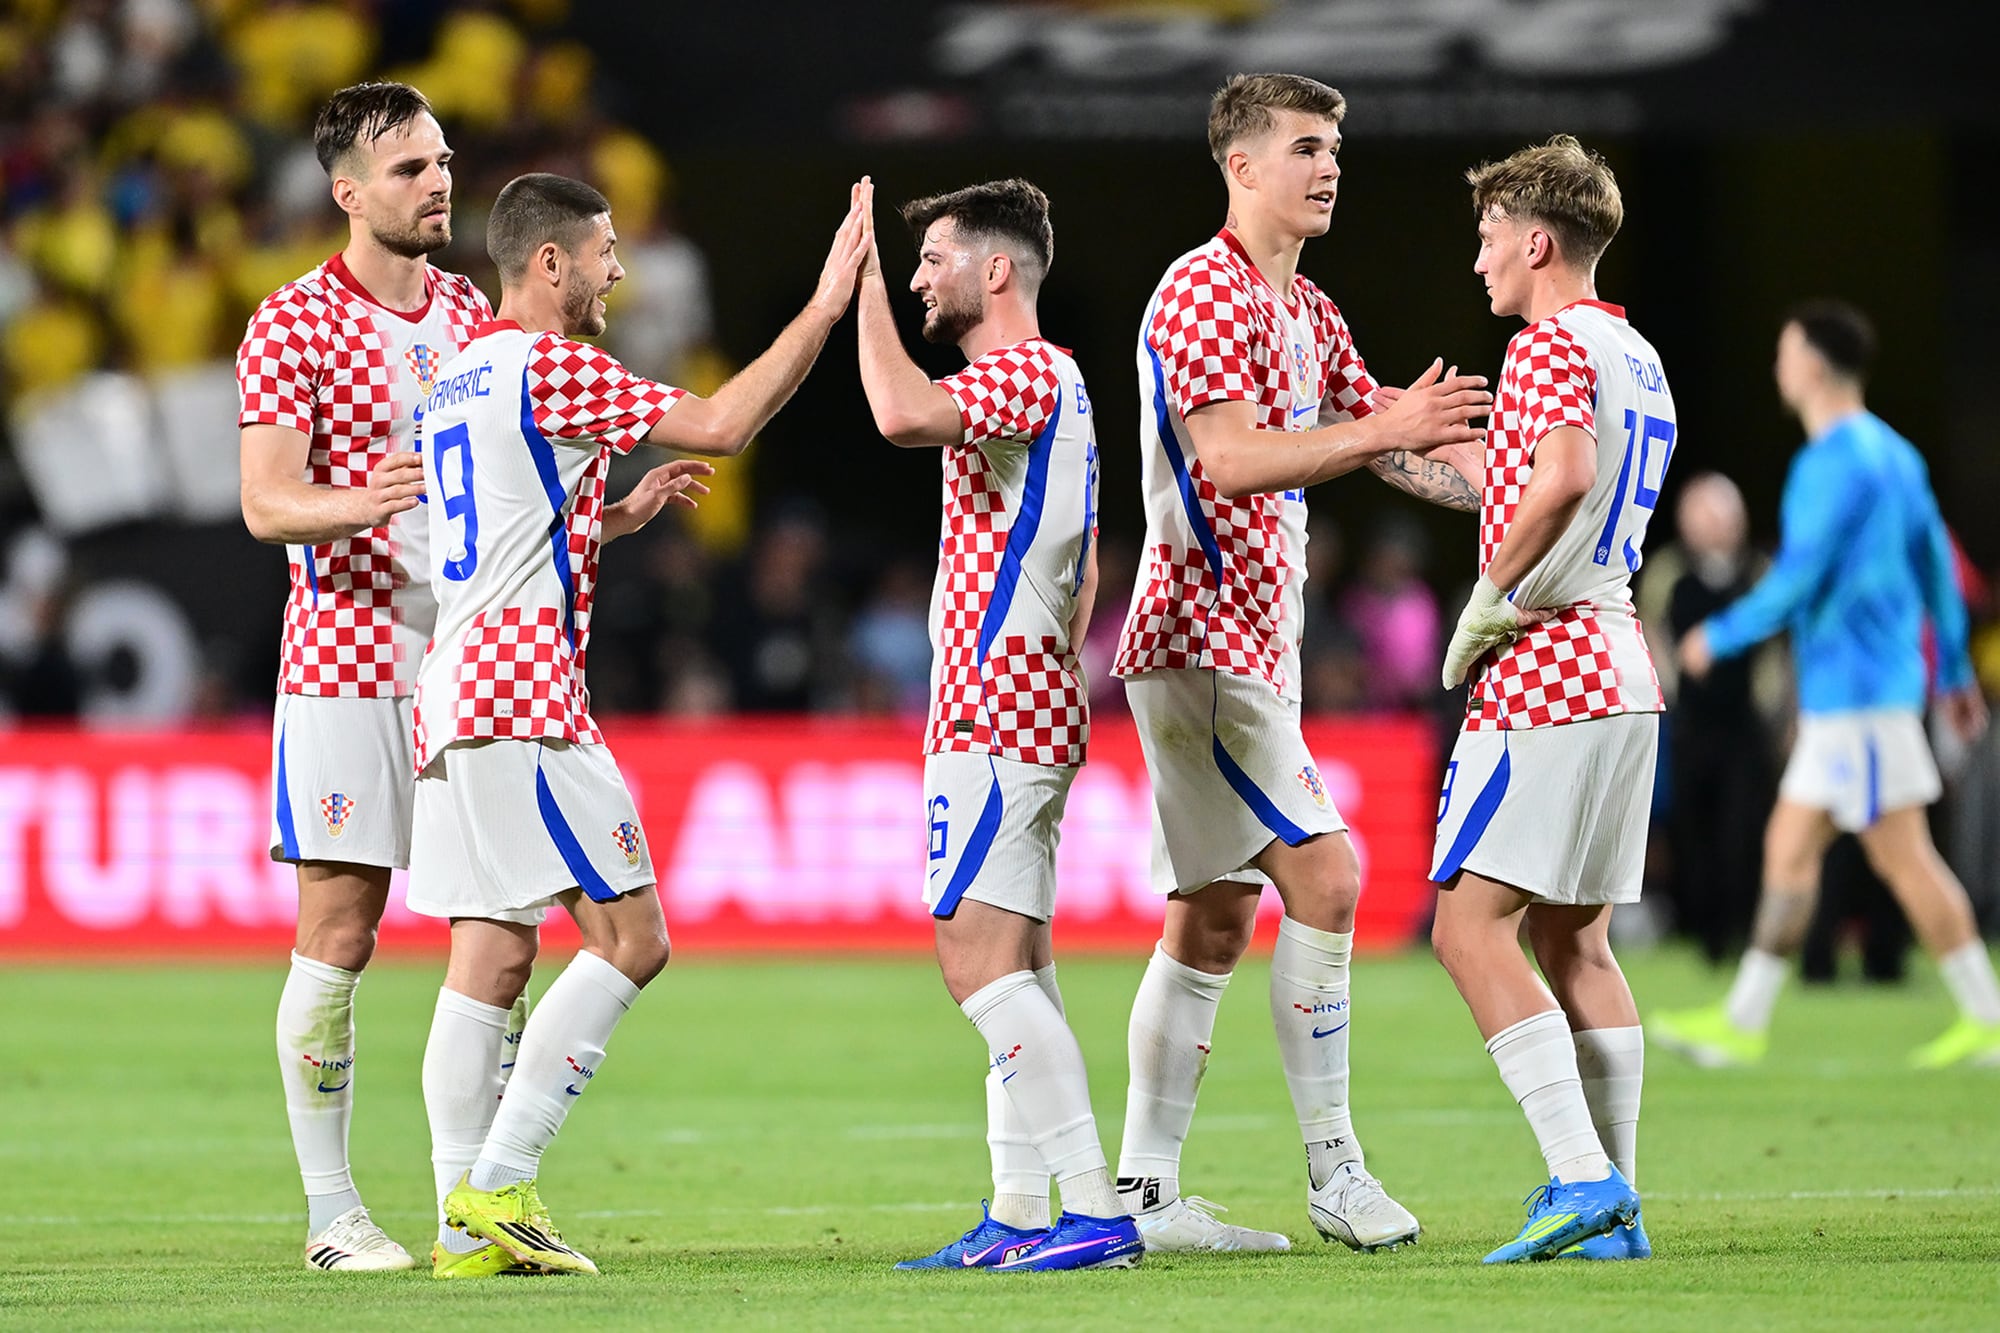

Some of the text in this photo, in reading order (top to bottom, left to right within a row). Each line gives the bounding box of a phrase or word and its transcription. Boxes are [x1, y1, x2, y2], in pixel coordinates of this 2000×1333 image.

[433, 421, 479, 582] 9
[1592, 408, 1676, 573] 19
[1313, 998, 1347, 1014] HNS
[321, 1056, 353, 1071] HNS
